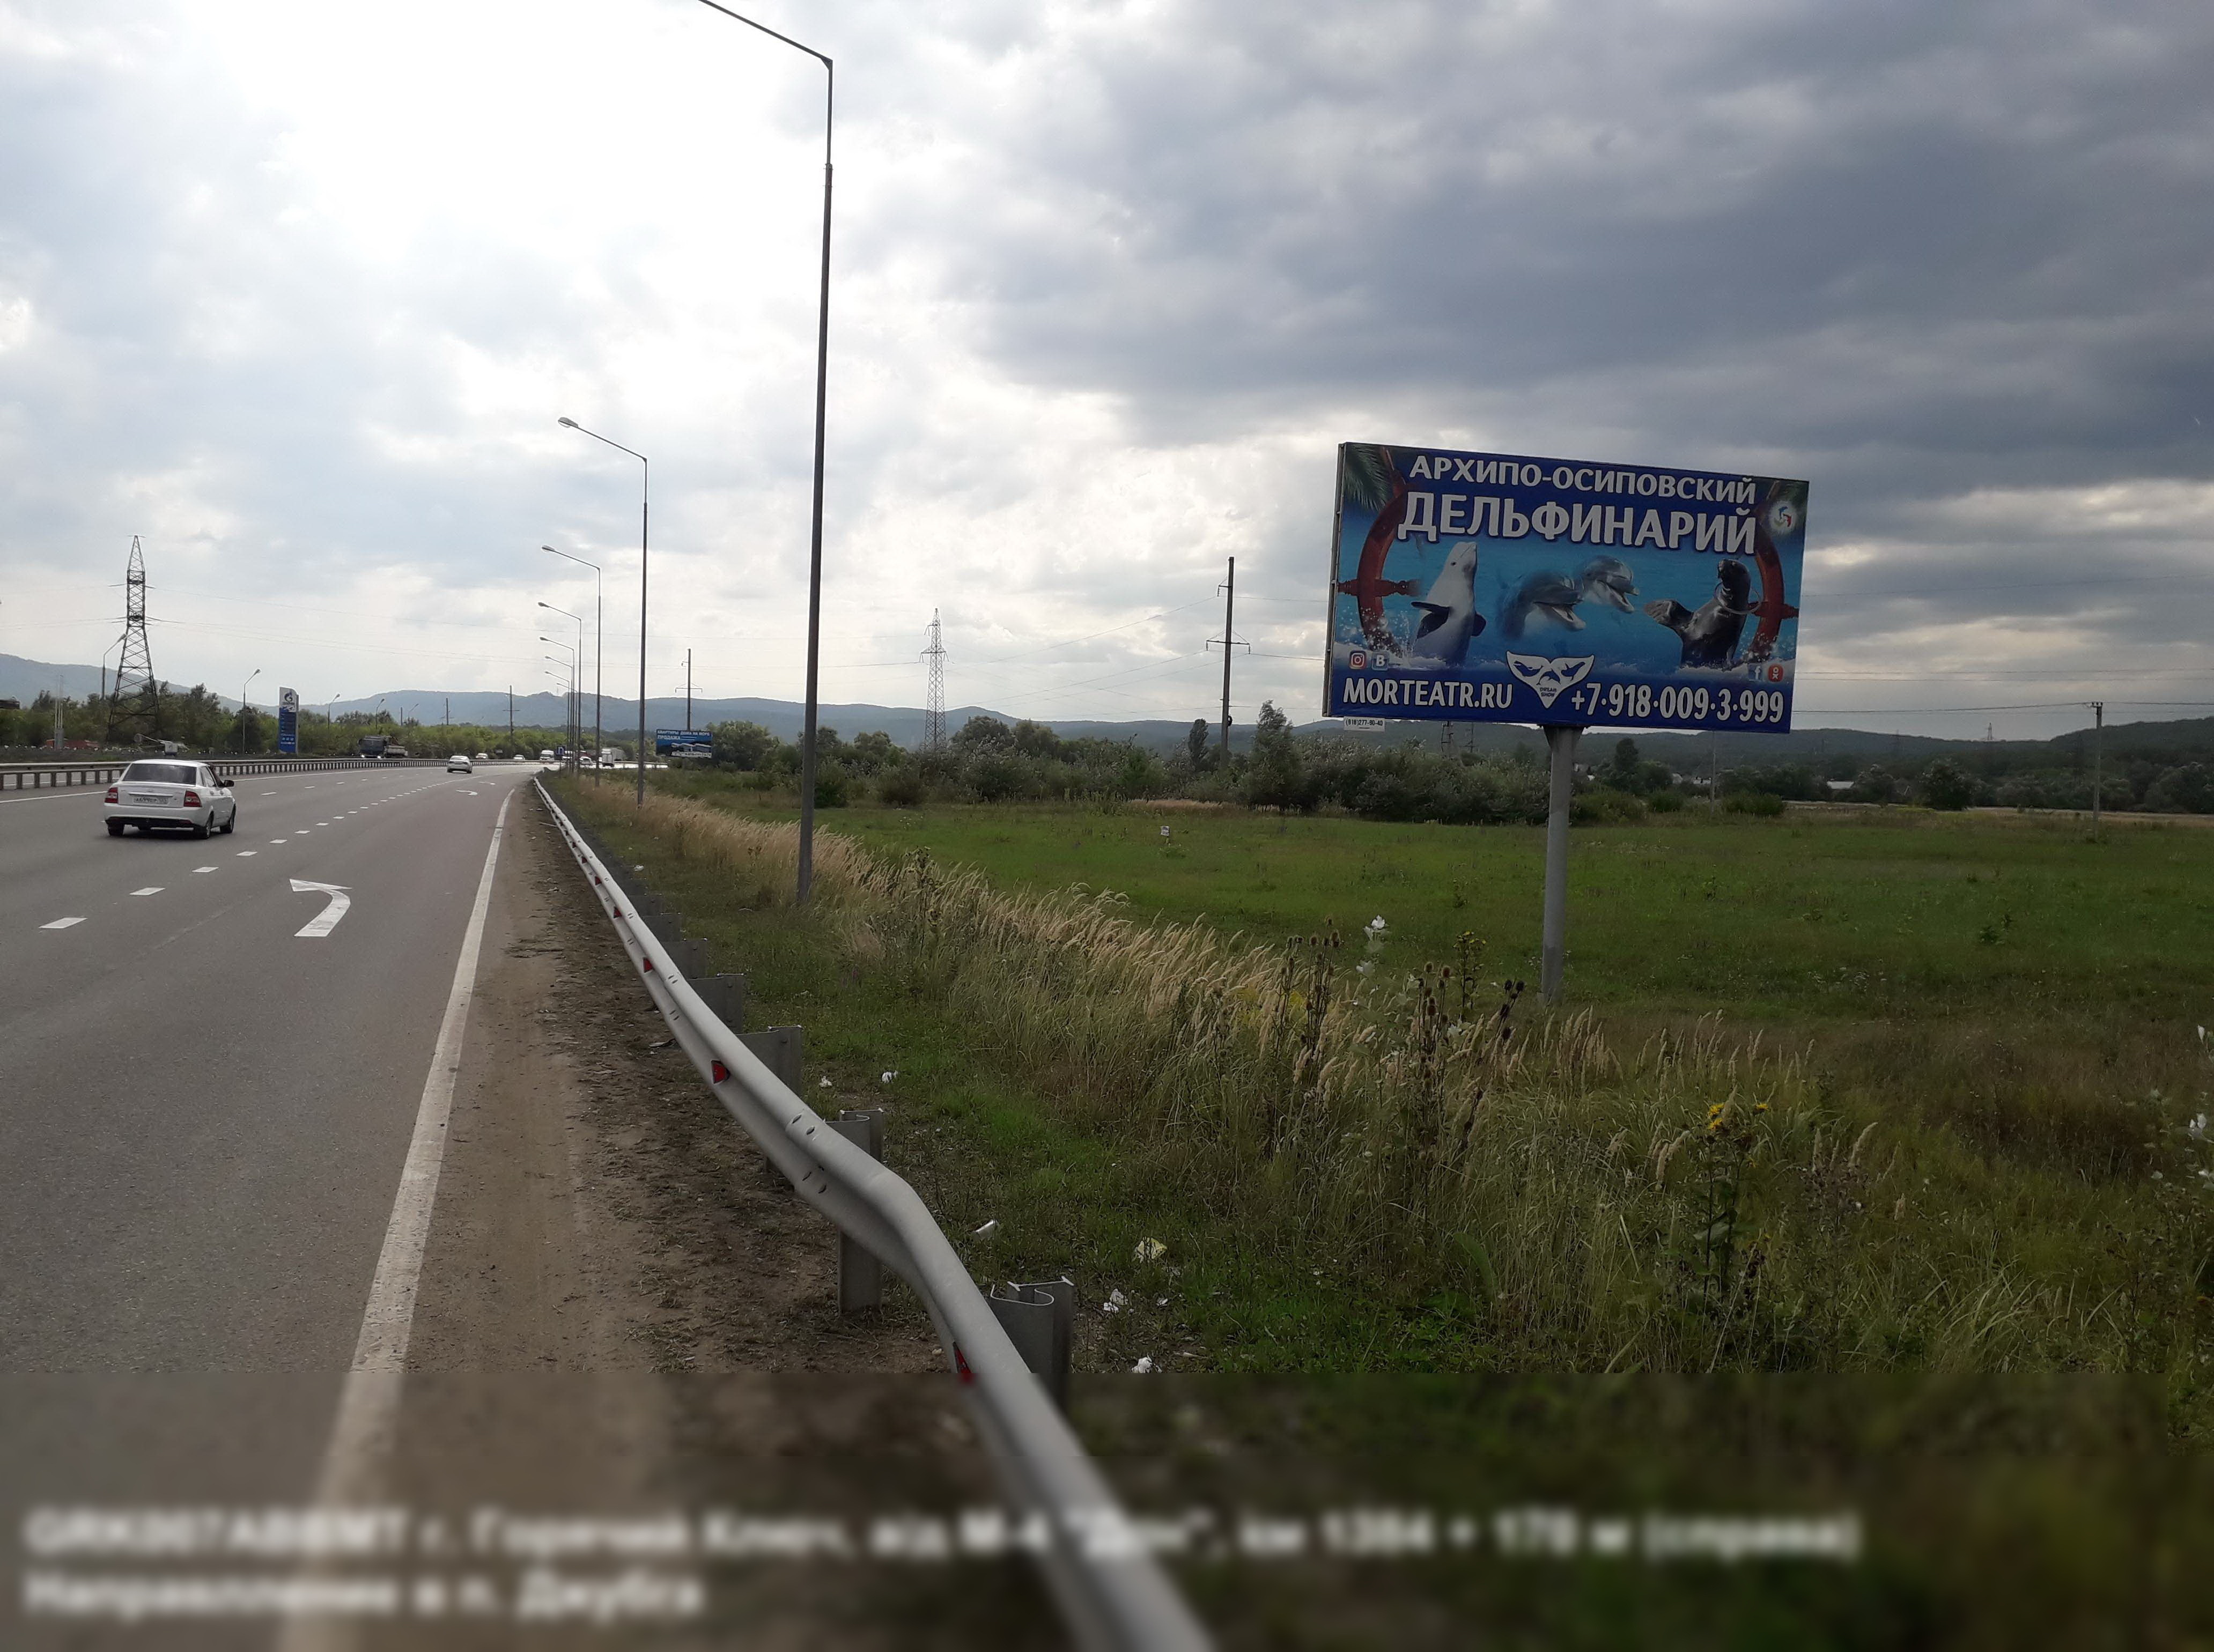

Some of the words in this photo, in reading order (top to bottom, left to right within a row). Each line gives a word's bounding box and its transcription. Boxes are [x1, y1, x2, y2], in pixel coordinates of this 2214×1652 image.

[1409, 455, 1756, 505] АРХИПО-ОСИПОВСКИЙ
[1397, 491, 1757, 554] ДЕЛЬФИНАРИЙ
[1343, 677, 1513, 709] MORTEATR.RU
